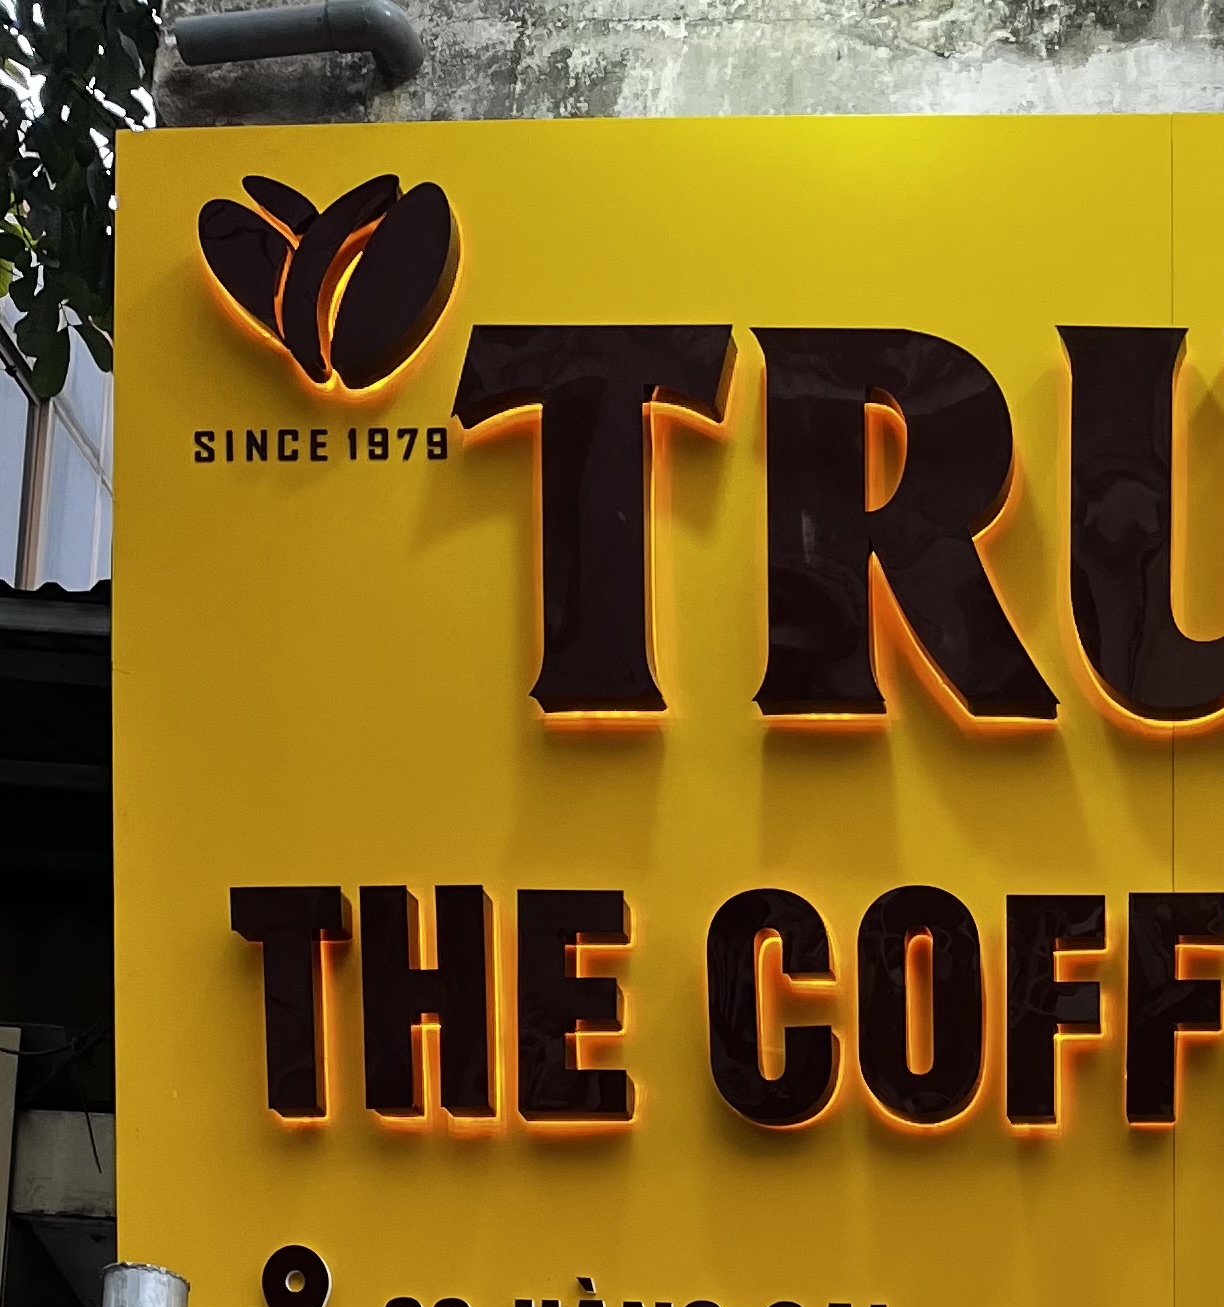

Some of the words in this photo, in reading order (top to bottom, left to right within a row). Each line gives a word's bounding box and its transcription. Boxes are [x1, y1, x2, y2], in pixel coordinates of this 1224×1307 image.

[194, 429, 330, 464] SINCE
[346, 427, 448, 462] 1979
[230, 884, 634, 1124] THE
